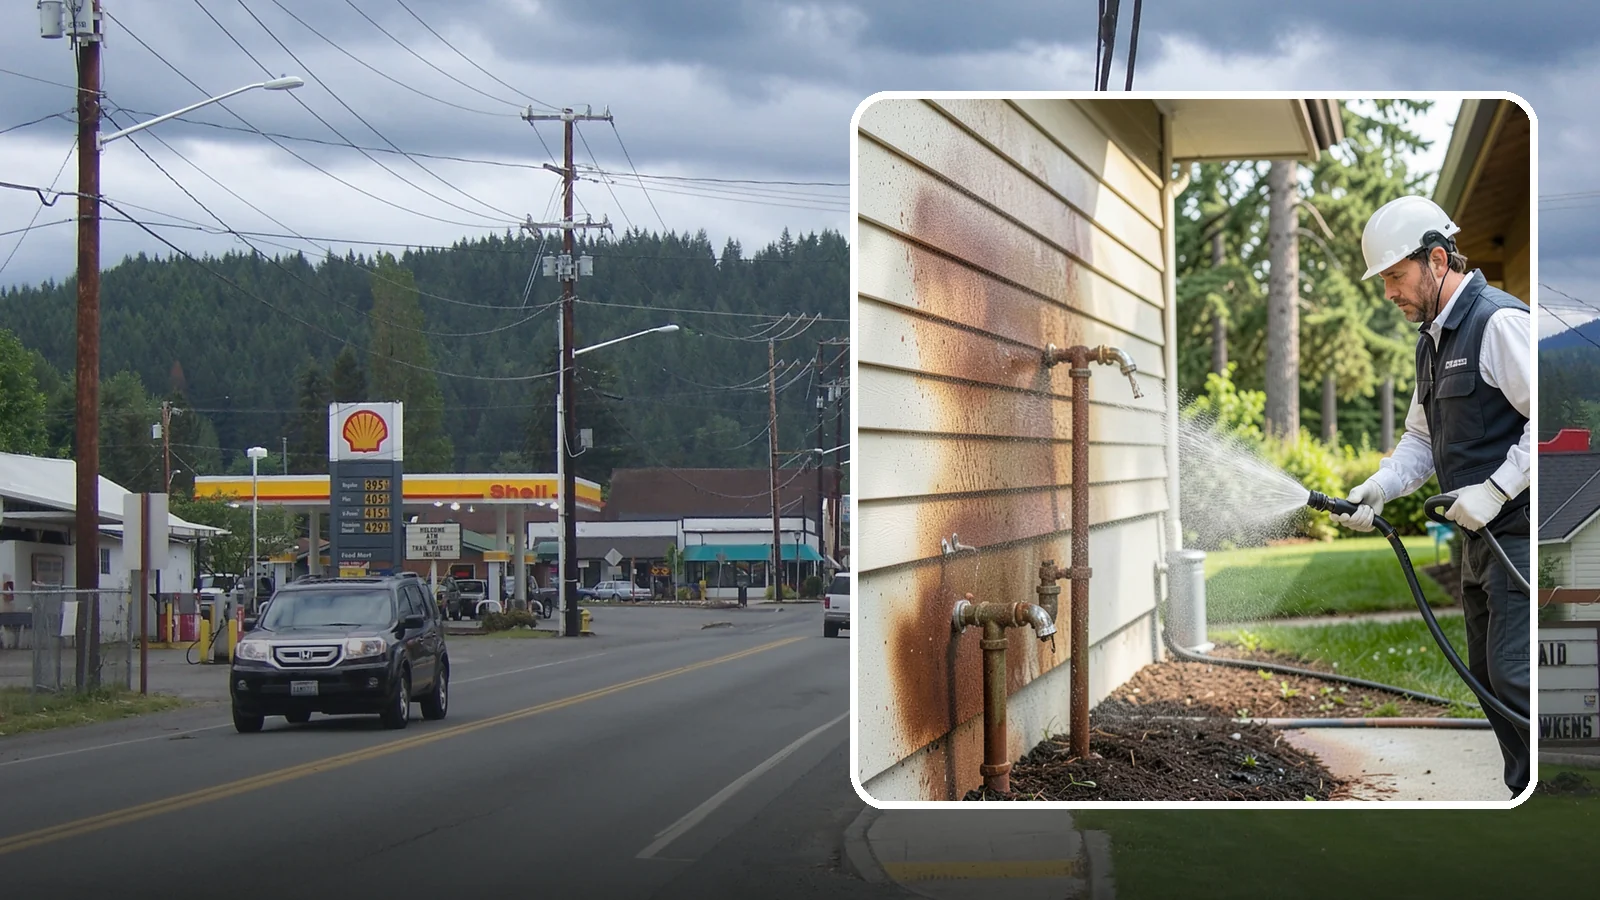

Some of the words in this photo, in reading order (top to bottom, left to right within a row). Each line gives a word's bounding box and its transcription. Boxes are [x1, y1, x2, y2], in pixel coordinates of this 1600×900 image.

[366, 480, 383, 490] 395
[490, 484, 547, 499] Shell
[366, 494, 383, 504] 405
[366, 508, 383, 518] 415
[366, 522, 383, 532] 429
